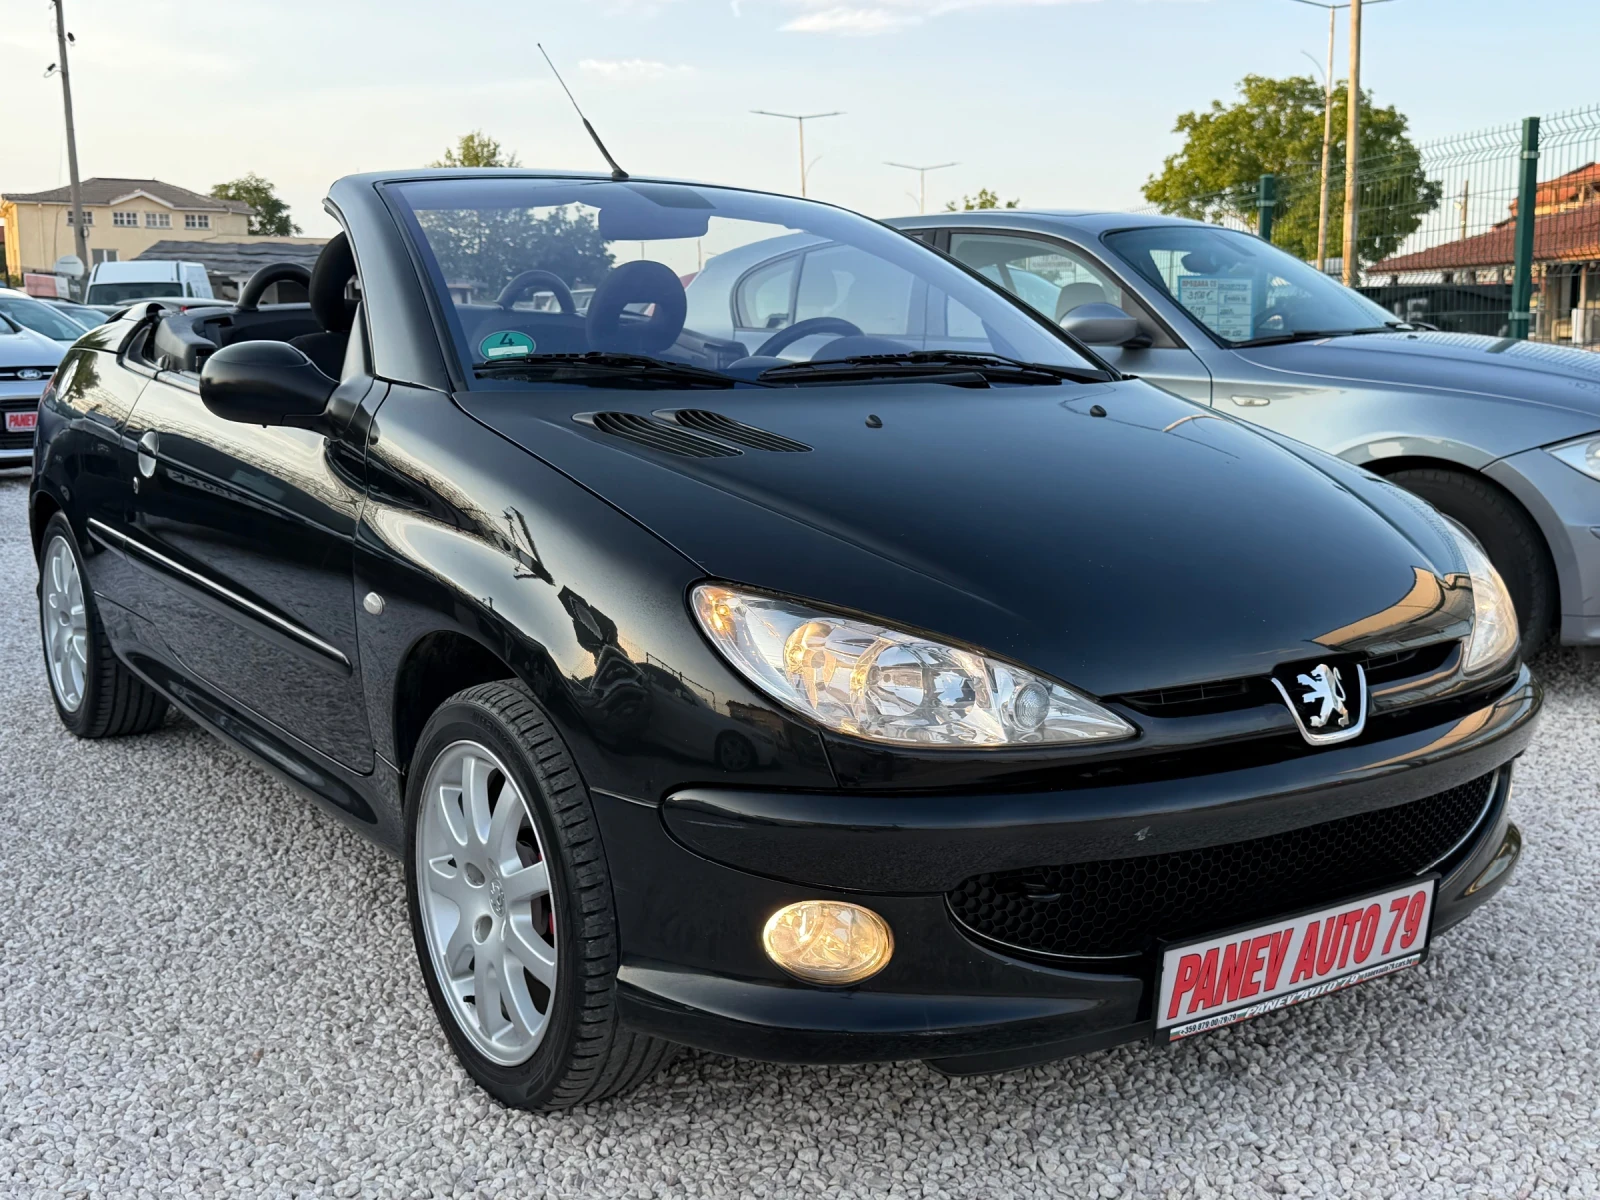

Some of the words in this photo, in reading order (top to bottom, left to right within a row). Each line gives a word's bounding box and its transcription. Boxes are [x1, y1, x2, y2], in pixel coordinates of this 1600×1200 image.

[499, 333, 515, 346] 4
[9, 413, 37, 428] PANEV
[1167, 927, 1294, 1020] PANEV
[1289, 903, 1381, 985] AUTO
[1381, 890, 1426, 956] 79
[1244, 993, 1298, 1018] PANEV
[1298, 981, 1337, 1002] AUTO
[1339, 974, 1359, 988] 79
